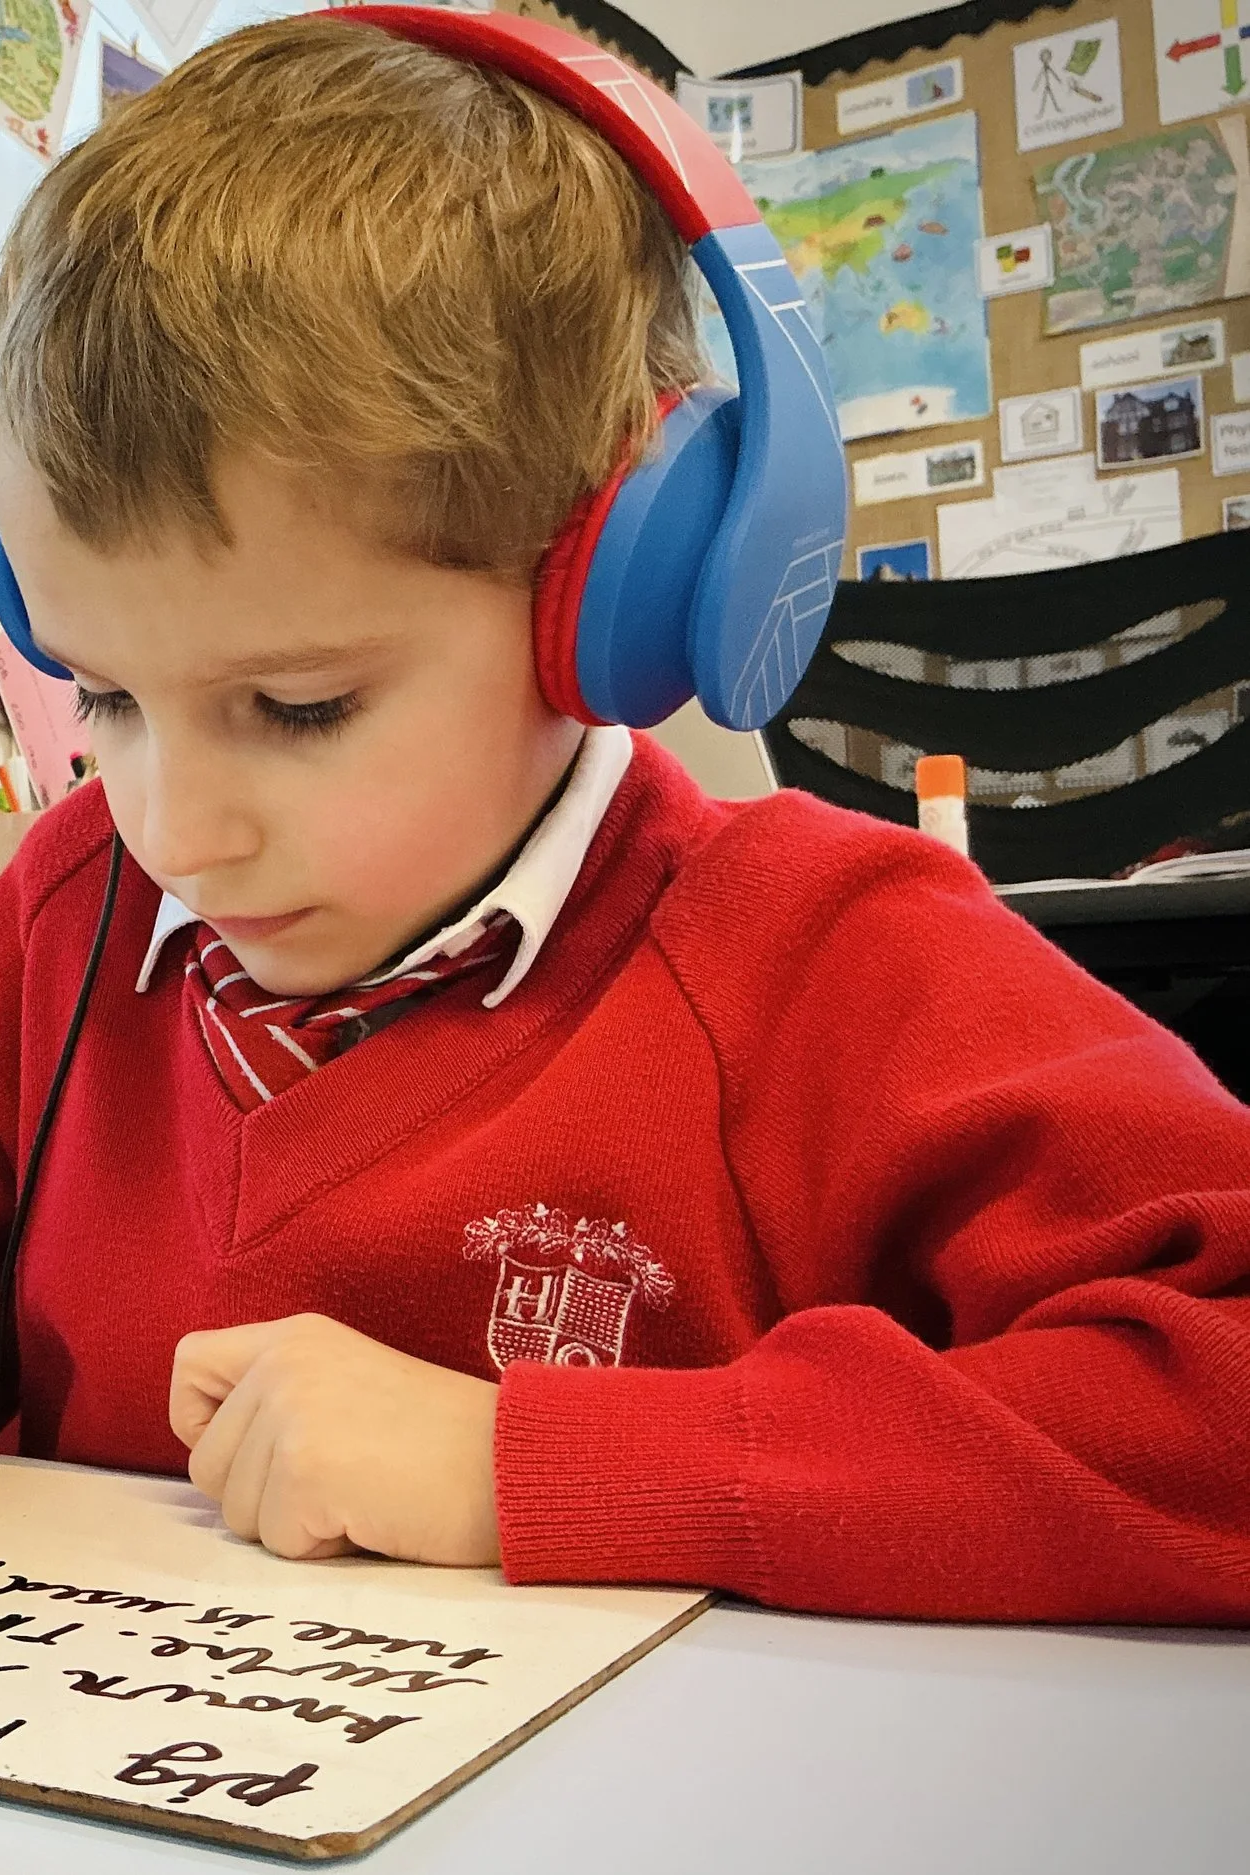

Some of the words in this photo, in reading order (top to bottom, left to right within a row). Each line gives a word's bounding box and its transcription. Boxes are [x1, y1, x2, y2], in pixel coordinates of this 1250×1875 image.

[186, 1606, 274, 1636] is
[289, 1620, 503, 1670] hide
[62, 1670, 421, 1744] known
[115, 1742, 319, 1806] pig
